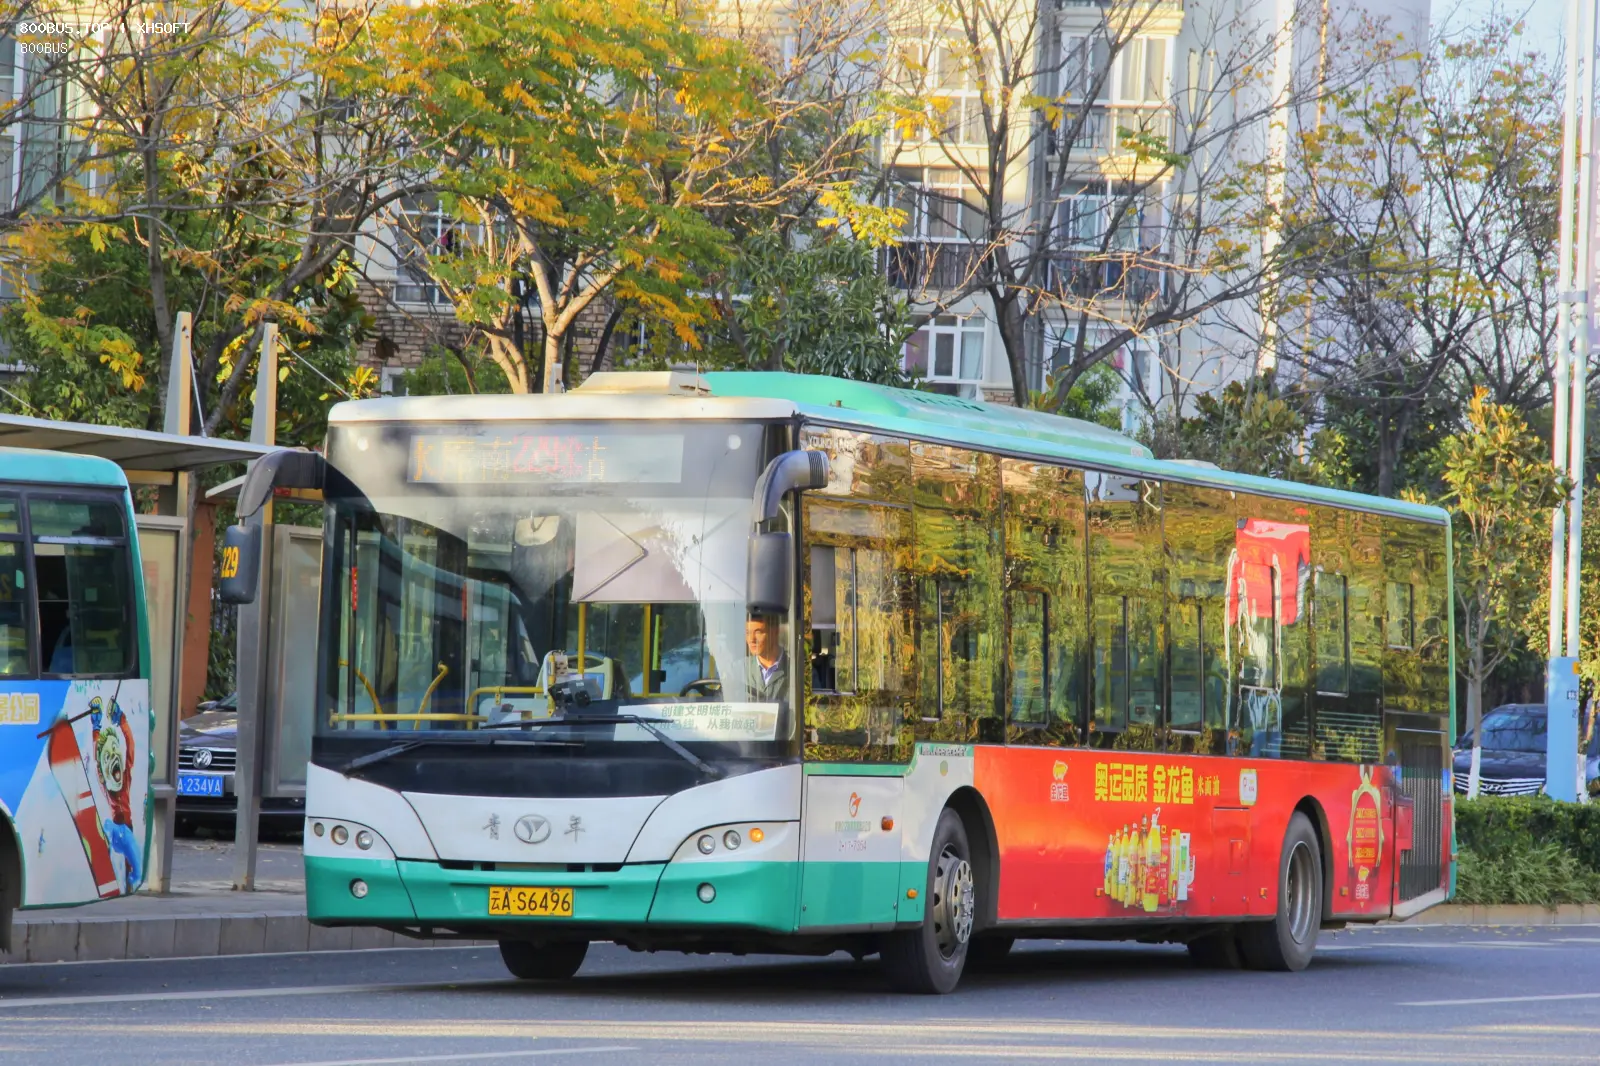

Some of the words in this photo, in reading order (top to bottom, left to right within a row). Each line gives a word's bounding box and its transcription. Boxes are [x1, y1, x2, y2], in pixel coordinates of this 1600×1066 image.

[661, 704, 733, 717] 创建文明城市
[1095, 762, 1148, 802] 奥运品质
[1153, 764, 1194, 804] 金龙鱼
